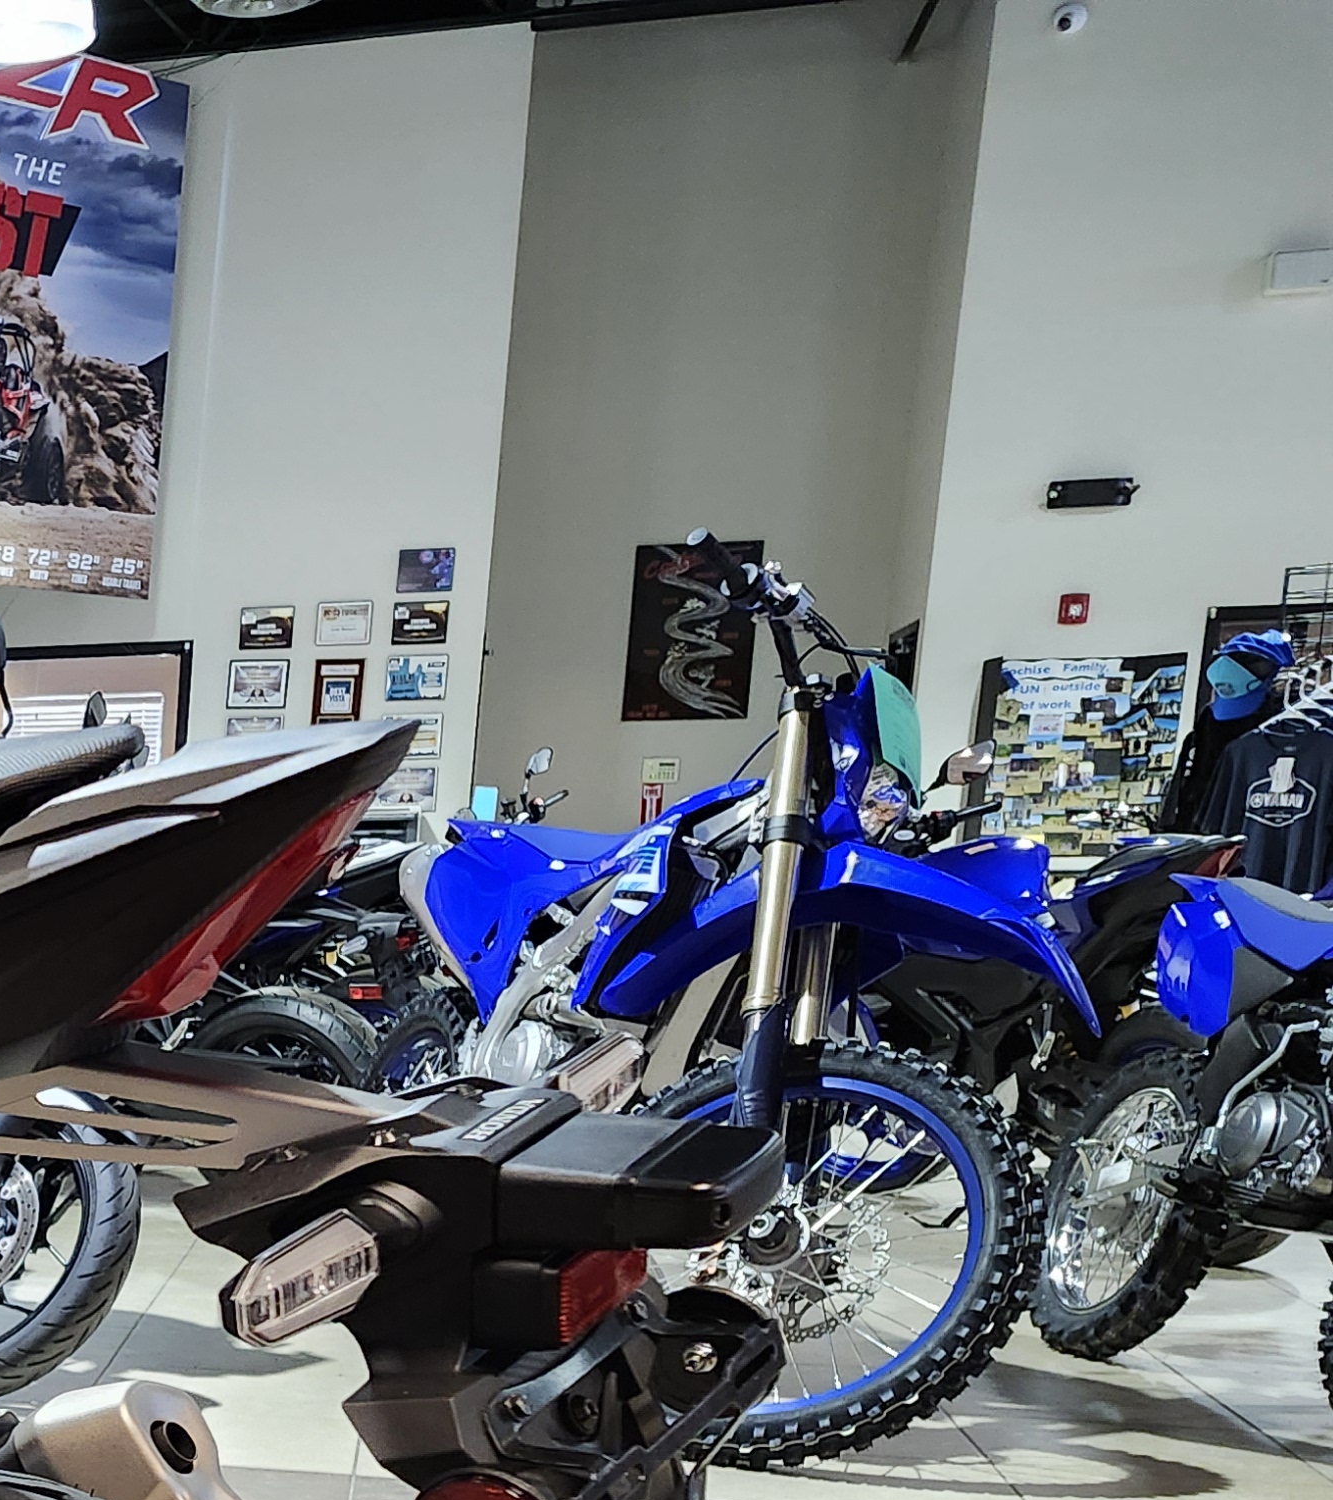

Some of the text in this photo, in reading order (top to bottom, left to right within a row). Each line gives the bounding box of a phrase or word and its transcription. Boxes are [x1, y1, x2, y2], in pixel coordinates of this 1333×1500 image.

[13, 153, 67, 186] THE
[28, 548, 59, 567] 72"
[67, 552, 100, 571] 32"
[111, 557, 144, 575] 25"
[1052, 682, 1101, 693] outside
[1021, 699, 1072, 711] of work
[461, 1098, 546, 1141] HONDA
